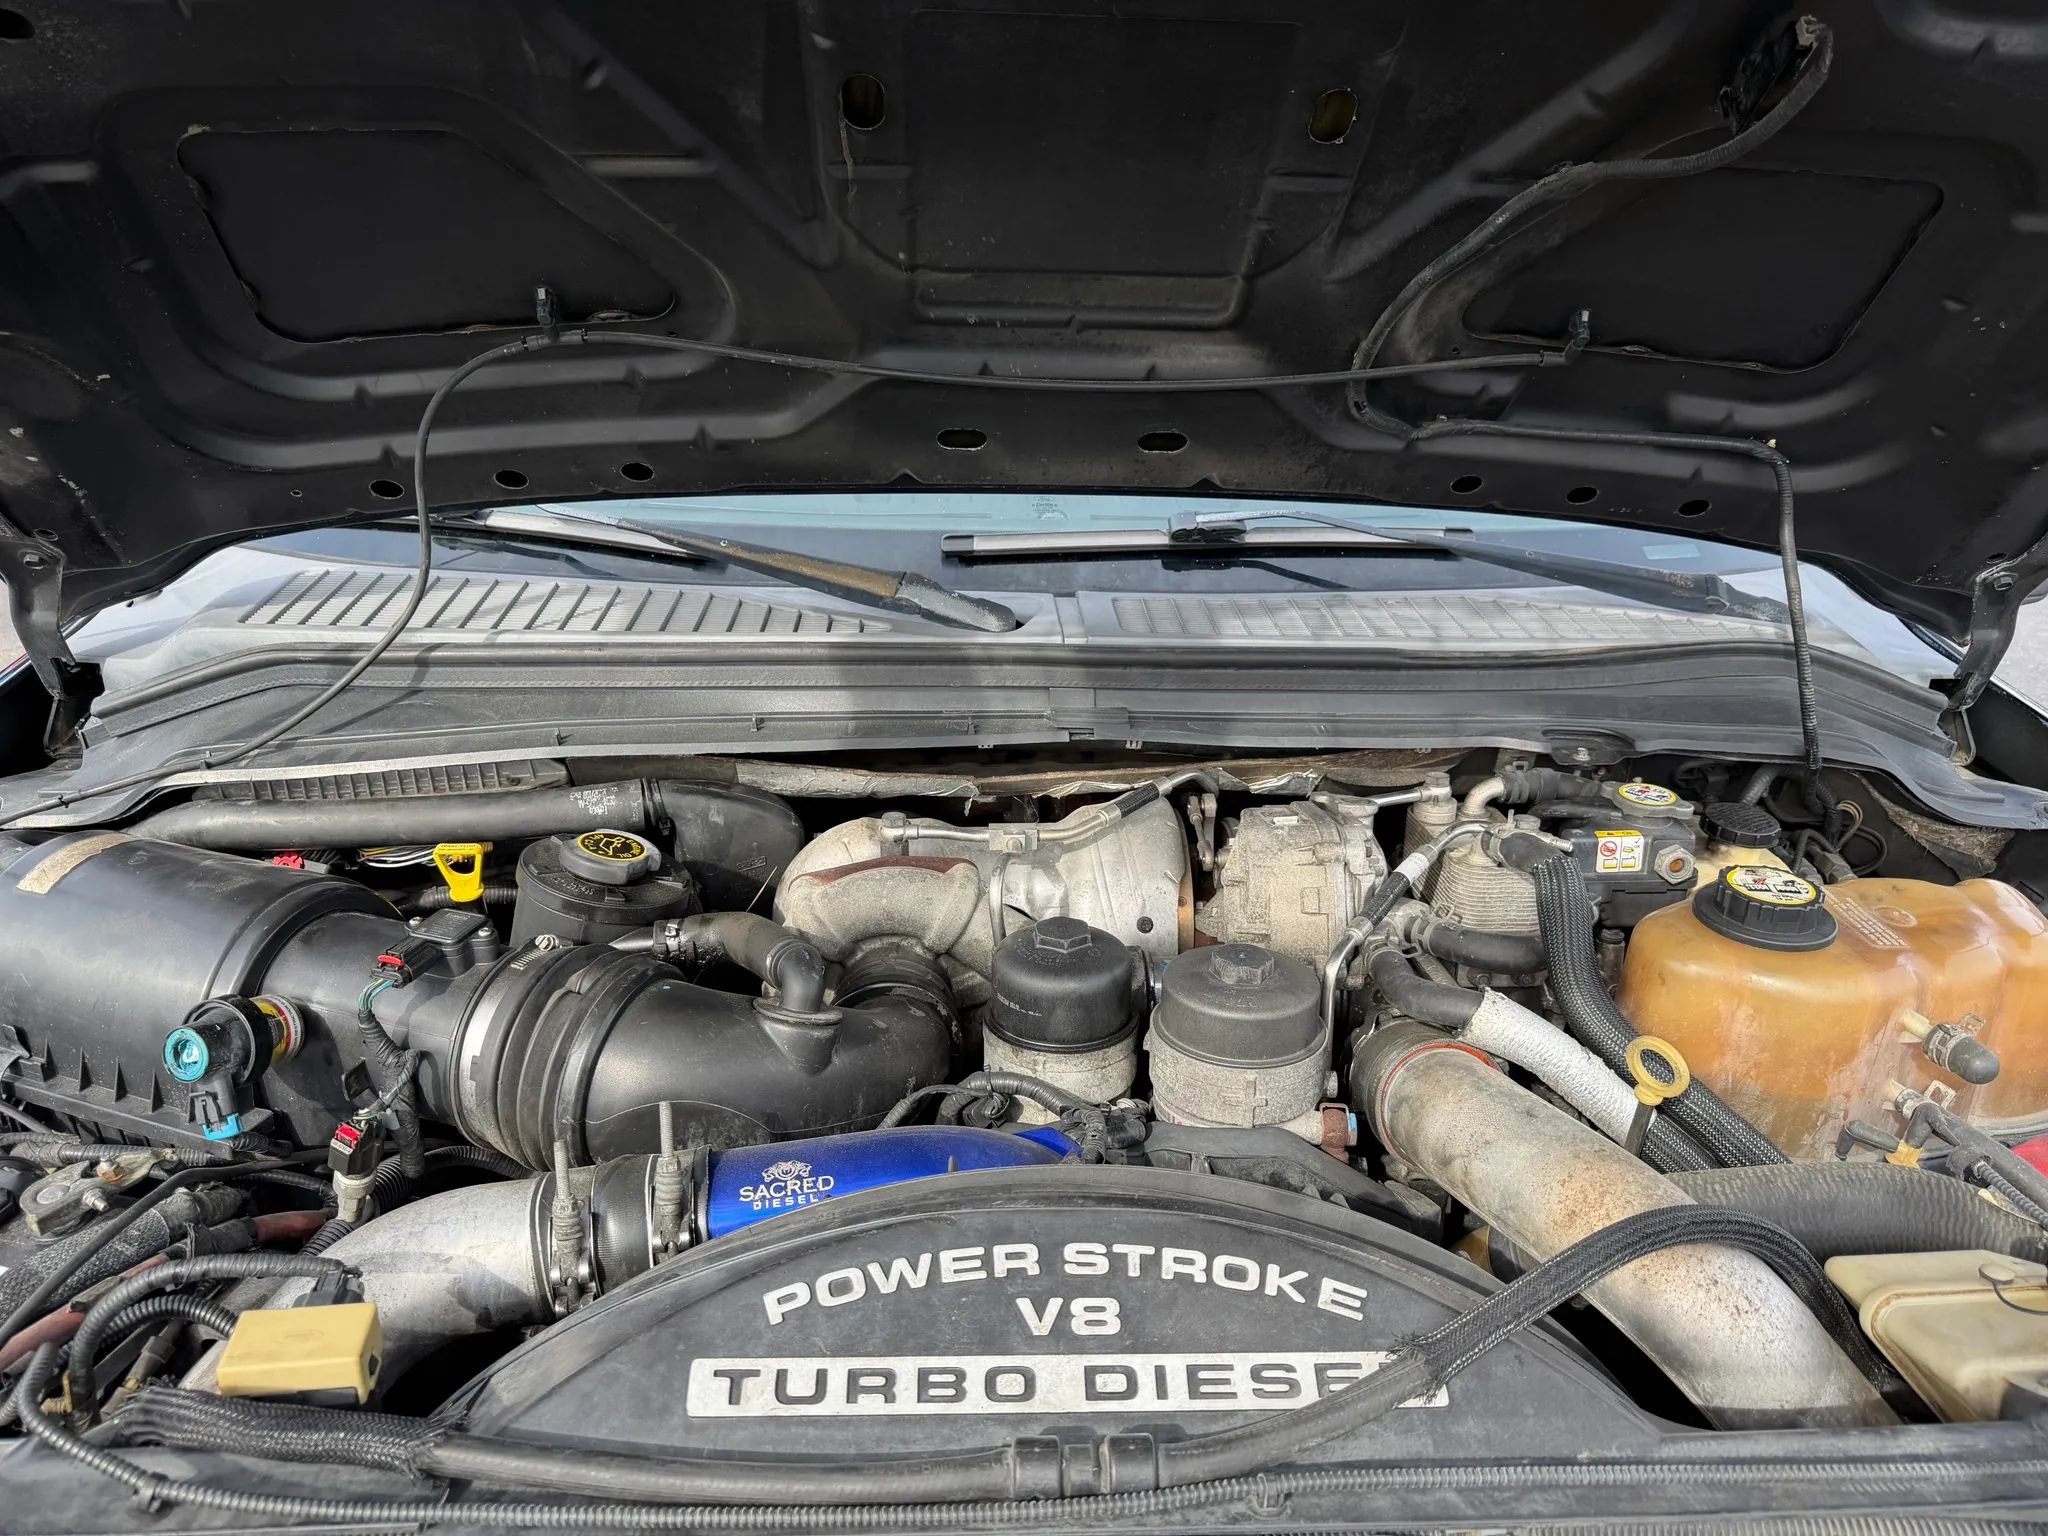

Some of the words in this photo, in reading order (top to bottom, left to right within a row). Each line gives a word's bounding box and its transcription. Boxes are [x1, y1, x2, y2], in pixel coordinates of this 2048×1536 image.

[739, 1175, 835, 1202] SACRED
[753, 1193, 819, 1211] DIESEL
[762, 1243, 1041, 1326] POWER
[1063, 1242, 1368, 1322] STROKE
[1015, 1297, 1122, 1336] V8
[713, 1365, 1037, 1406] TURBO
[1083, 1362, 1390, 1402] DIESE
